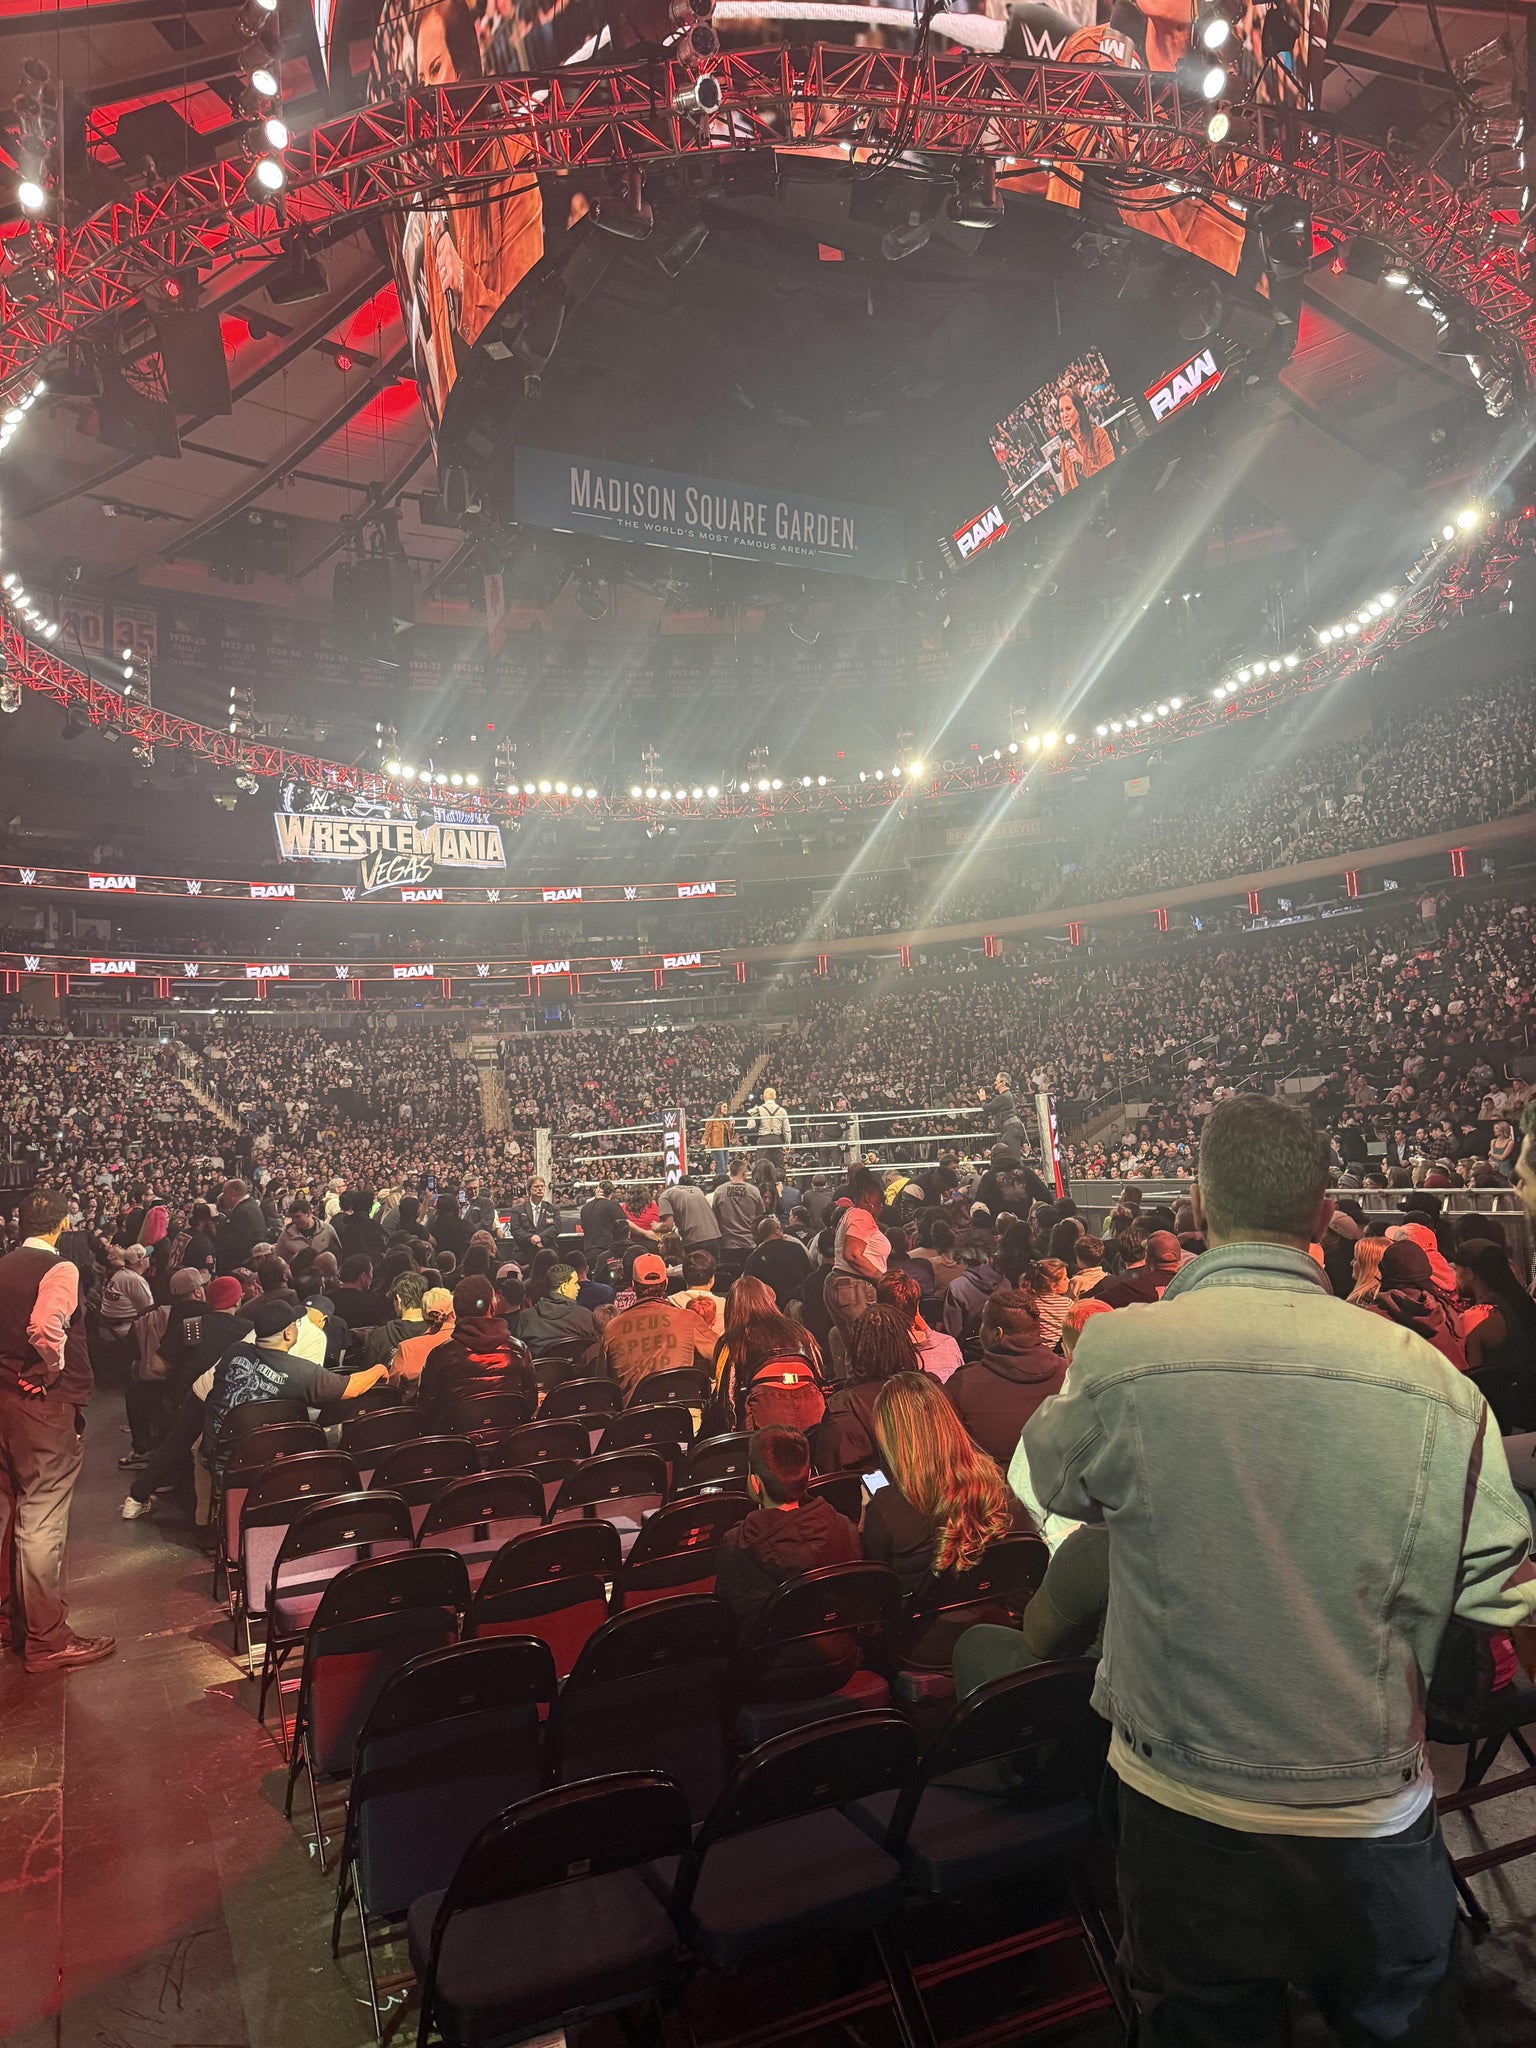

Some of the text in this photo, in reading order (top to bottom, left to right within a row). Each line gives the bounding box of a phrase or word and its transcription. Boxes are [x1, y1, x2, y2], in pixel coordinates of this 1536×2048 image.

[1148, 348, 1218, 422] RAW
[570, 467, 856, 551] MADISON SQUARE GARDEN
[617, 519, 640, 529] THE
[644, 523, 696, 539] WORLD'S
[699, 533, 730, 543] MOST
[733, 537, 778, 551] FAMOUS
[956, 505, 1004, 559] RAW
[277, 814, 504, 864] WRESTLEMANIA
[361, 849, 434, 890] VEGAS
[88, 874, 137, 890] RAW
[250, 883, 296, 899] RAW
[400, 887, 444, 903] RAW
[542, 887, 583, 903] RAW
[676, 881, 718, 899] RAW
[90, 960, 137, 975] RAW
[245, 963, 291, 982] RAW
[394, 963, 436, 979] RAW
[532, 960, 571, 976] RAW
[663, 952, 702, 970] RAW
[621, 1313, 672, 1335] DEUS
[614, 1332, 678, 1356] SPEED
